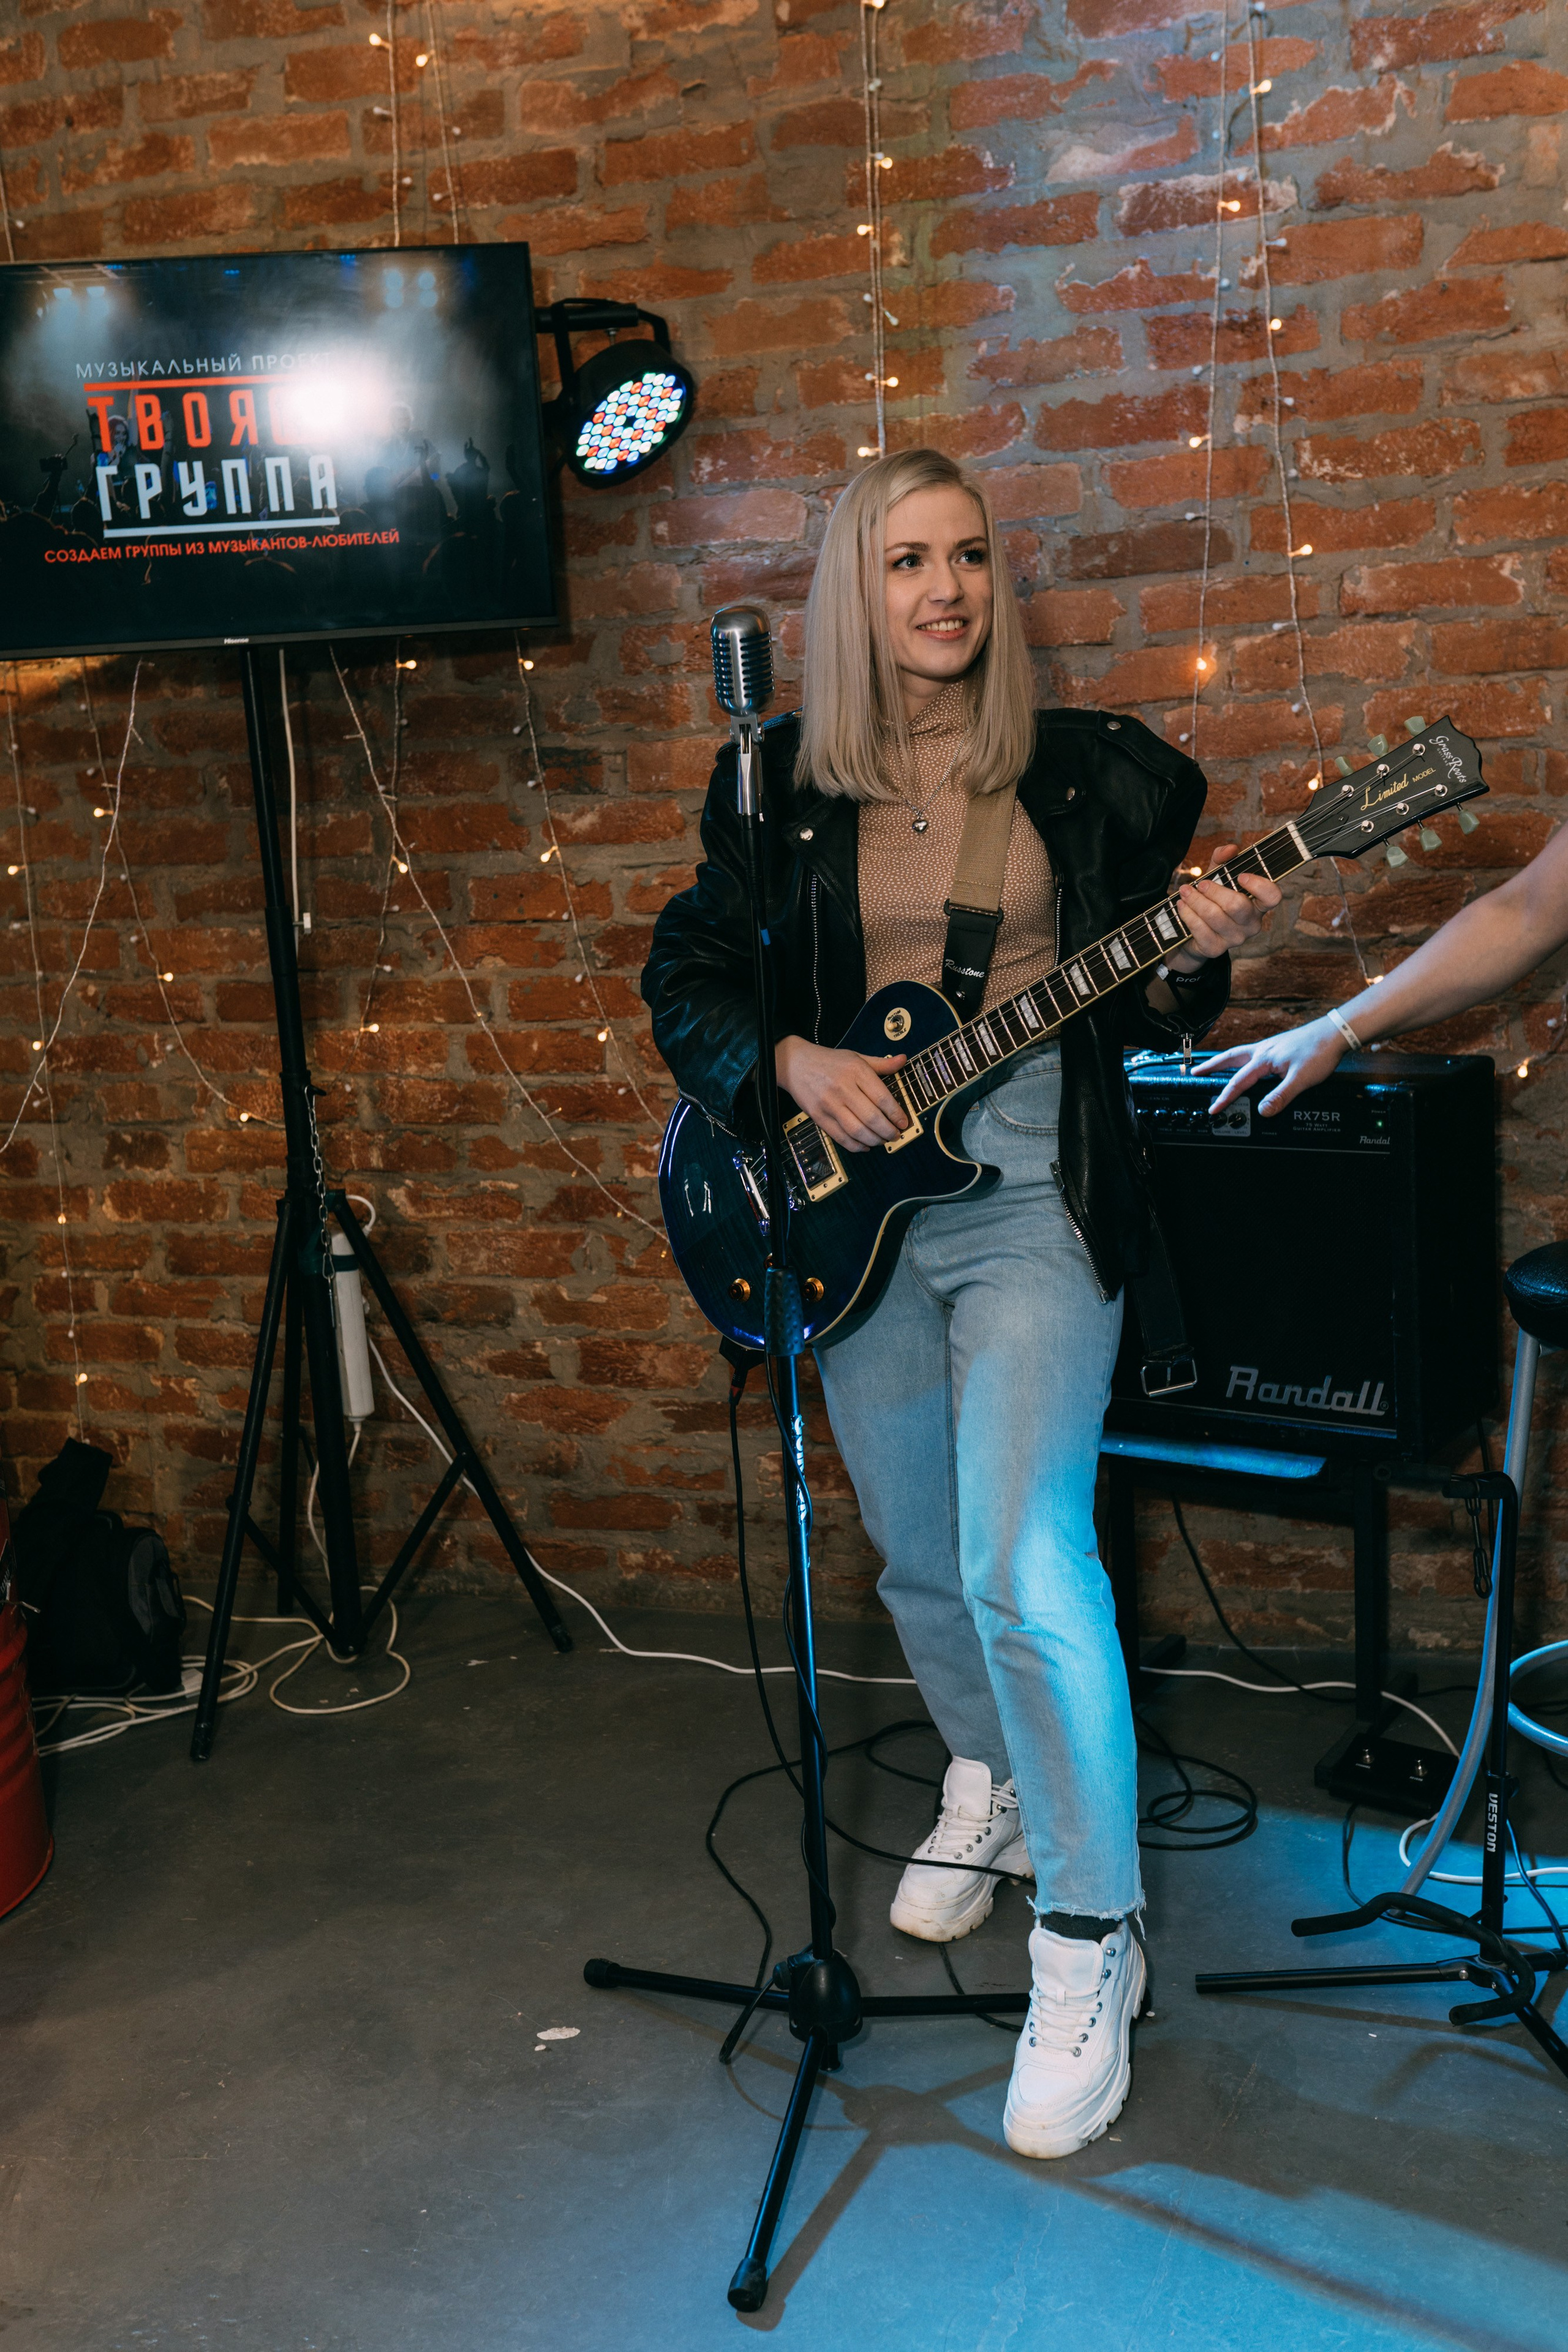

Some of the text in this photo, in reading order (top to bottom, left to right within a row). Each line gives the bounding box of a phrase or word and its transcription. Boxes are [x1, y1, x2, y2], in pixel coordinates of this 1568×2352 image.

[76, 353, 241, 378] МУЗЫКАЛЬНЫЙ
[87, 389, 258, 452] ТВОЯ
[96, 454, 337, 521] ГРУППА
[45, 528, 399, 563] СОЗДАЕМ ГРУППЫ ИЗ МУЗЫКАНТОВ-ЛЮБИТЕЛЕЙ
[1360, 767, 1436, 811] Limited MODEL
[944, 959, 985, 978] Russtone
[1294, 1110, 1341, 1121] RX75R
[1226, 1365, 1385, 1416] Randall
[1487, 1792, 1498, 1853] VESTON
